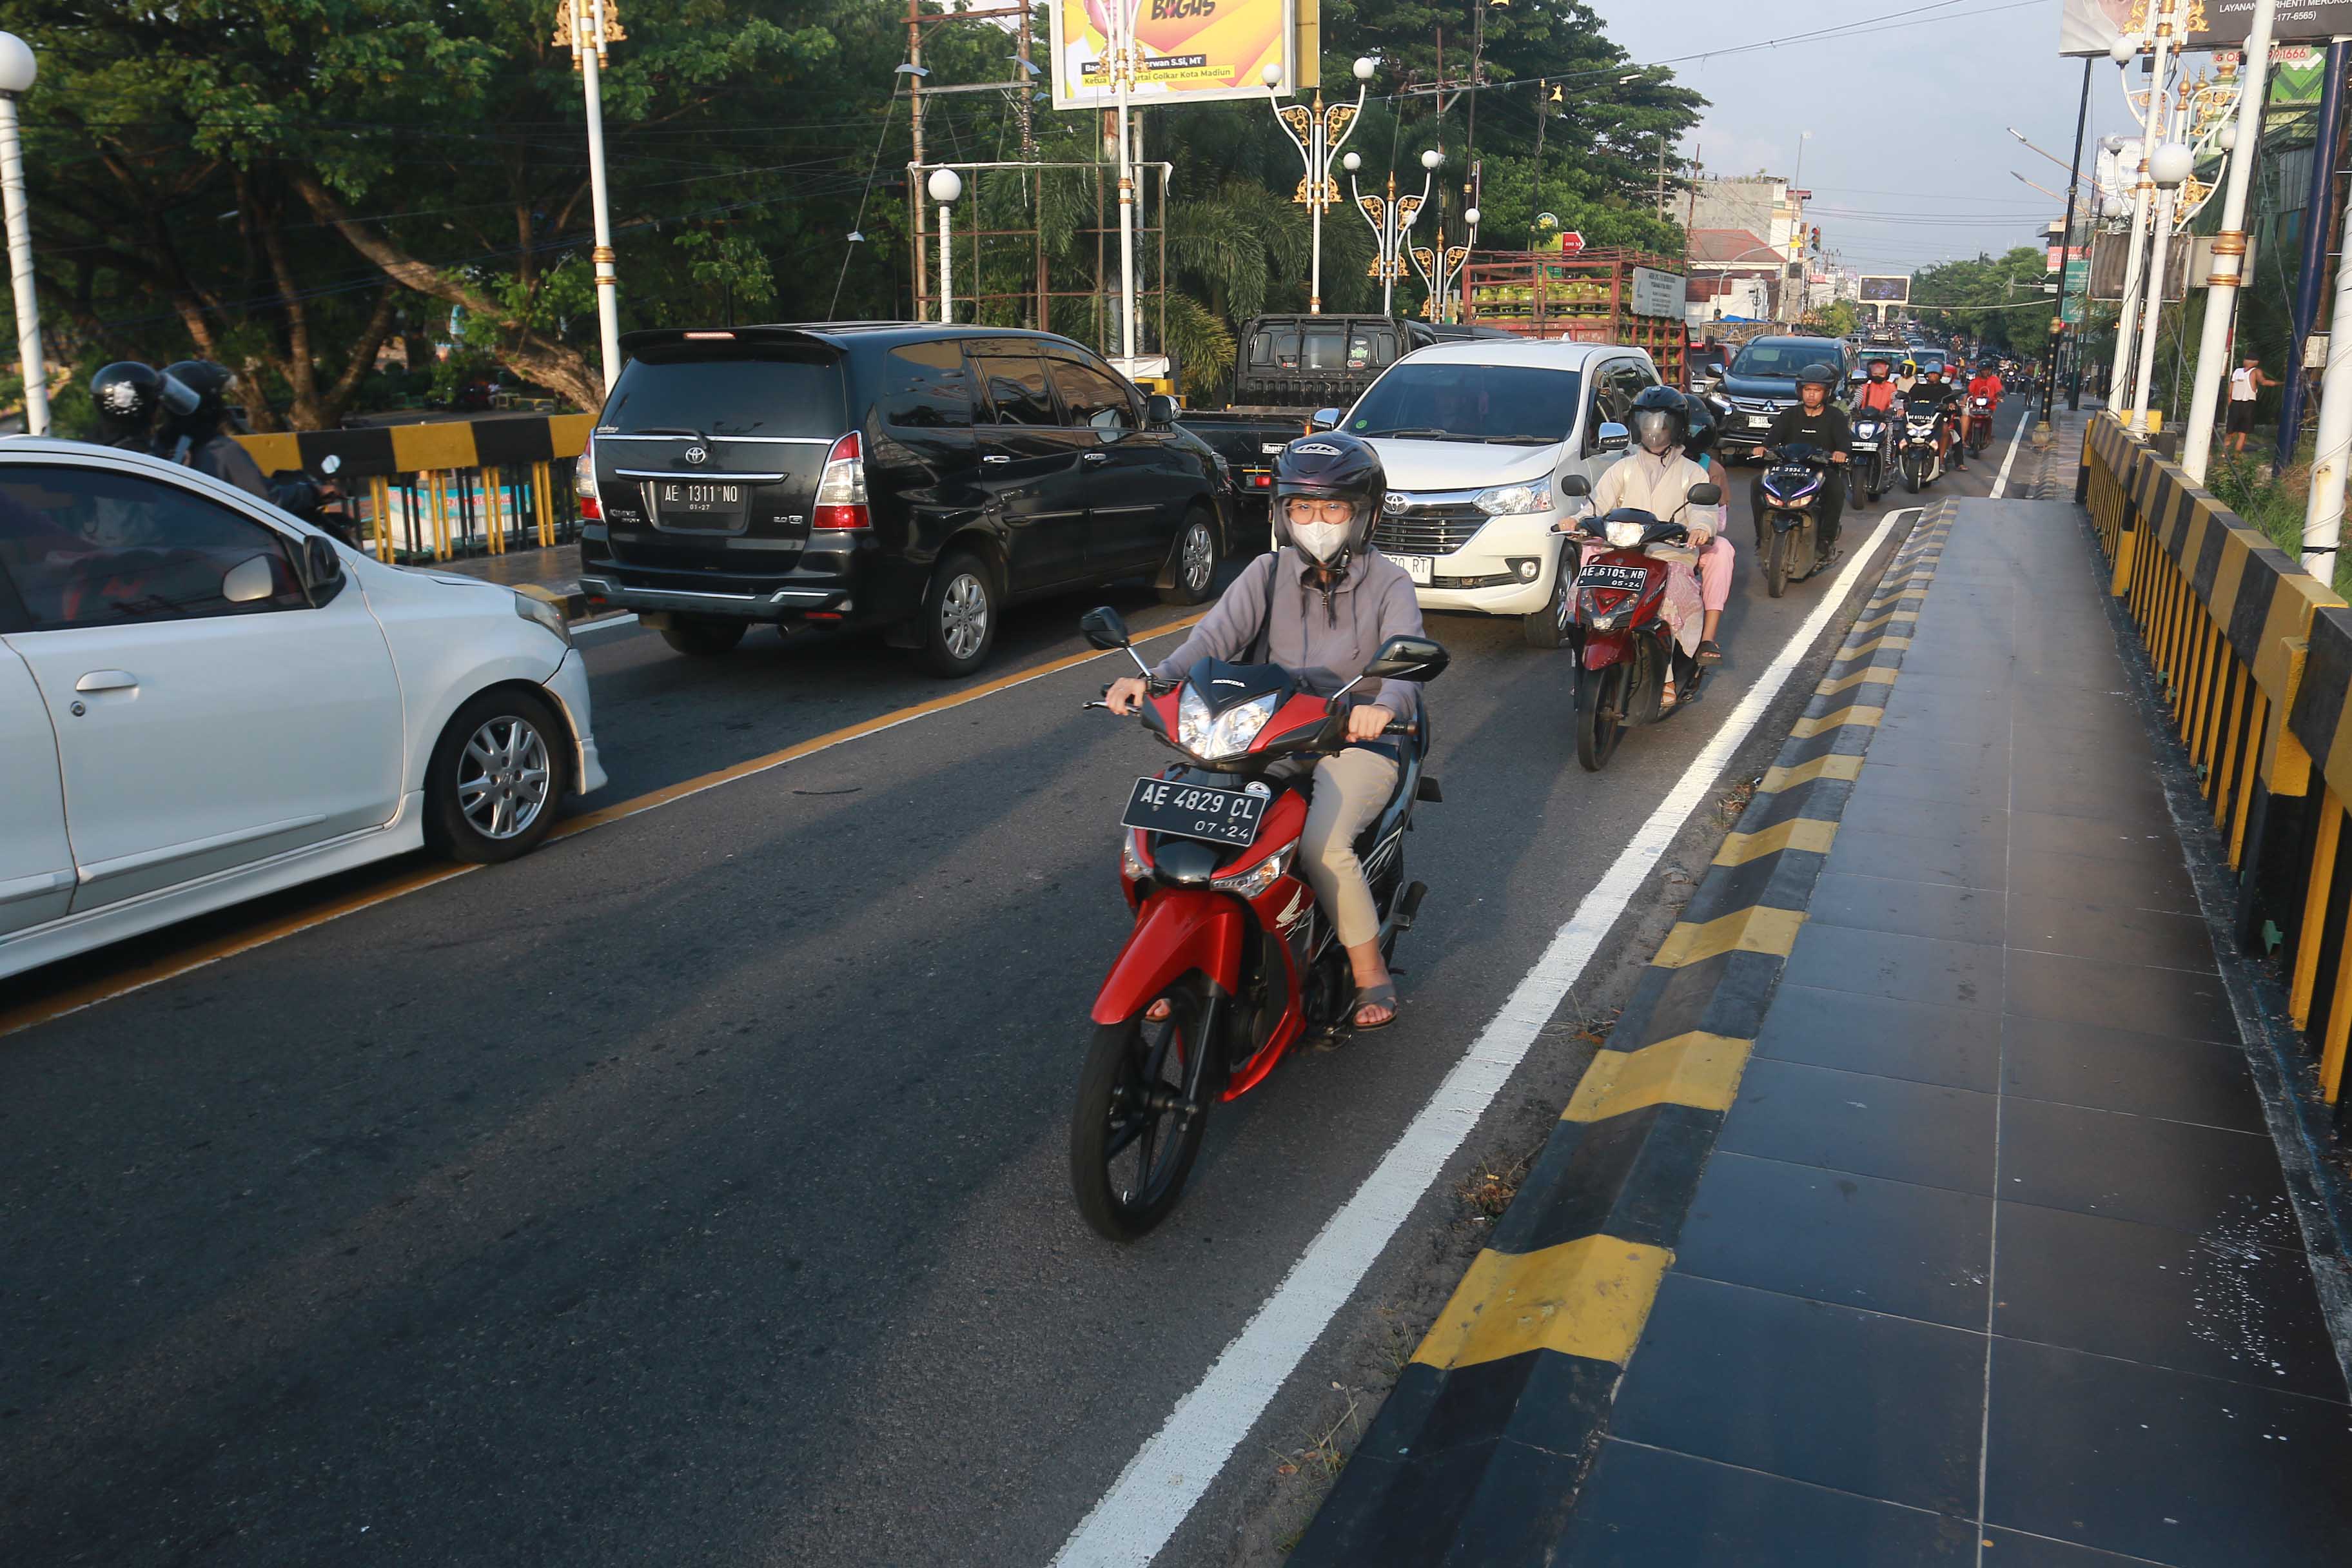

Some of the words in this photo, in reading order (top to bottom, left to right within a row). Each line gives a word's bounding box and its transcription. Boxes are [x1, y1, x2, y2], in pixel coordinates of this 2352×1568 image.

[2275, 0, 2306, 8] RHENTI
[2273, 11, 2317, 21] -177-6565)
[665, 485, 679, 502] AE
[689, 485, 714, 502] 1311
[723, 485, 738, 502] NO
[1413, 558, 1427, 573] RT
[1581, 567, 1595, 576] AE
[1599, 567, 1626, 578] 6105
[1211, 679, 1246, 688] HONDA
[1140, 783, 1171, 805] AE
[1173, 789, 1225, 813] 4829
[1230, 799, 1253, 819] CL
